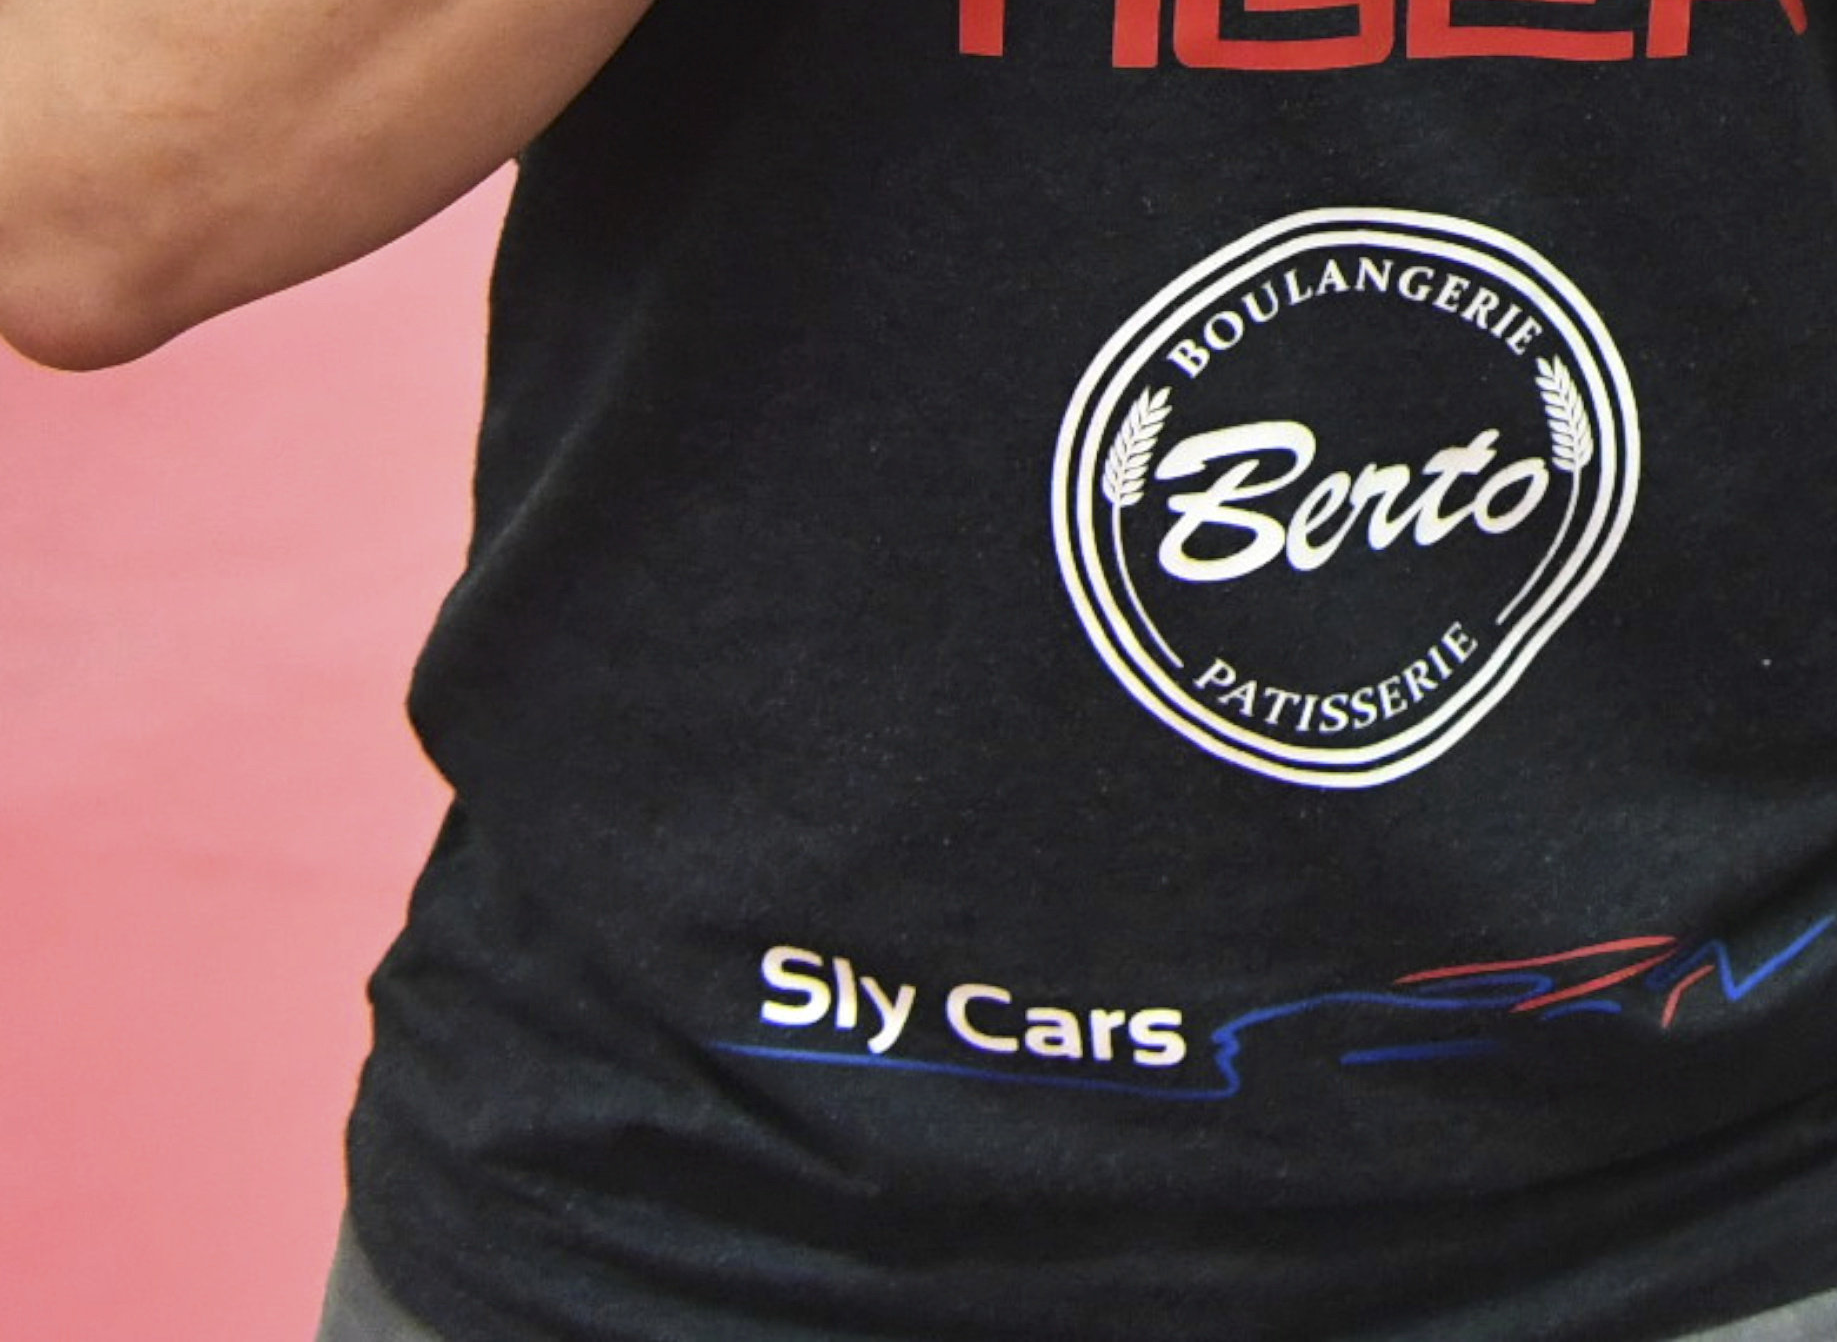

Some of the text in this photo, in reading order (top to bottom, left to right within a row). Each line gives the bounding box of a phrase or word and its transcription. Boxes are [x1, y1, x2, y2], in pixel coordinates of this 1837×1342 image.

[1166, 257, 1543, 379] BOULANGERIE
[1154, 421, 1549, 582] Berto
[1193, 620, 1480, 732] PATISSERIE
[760, 945, 1188, 1067] Sly Cars
